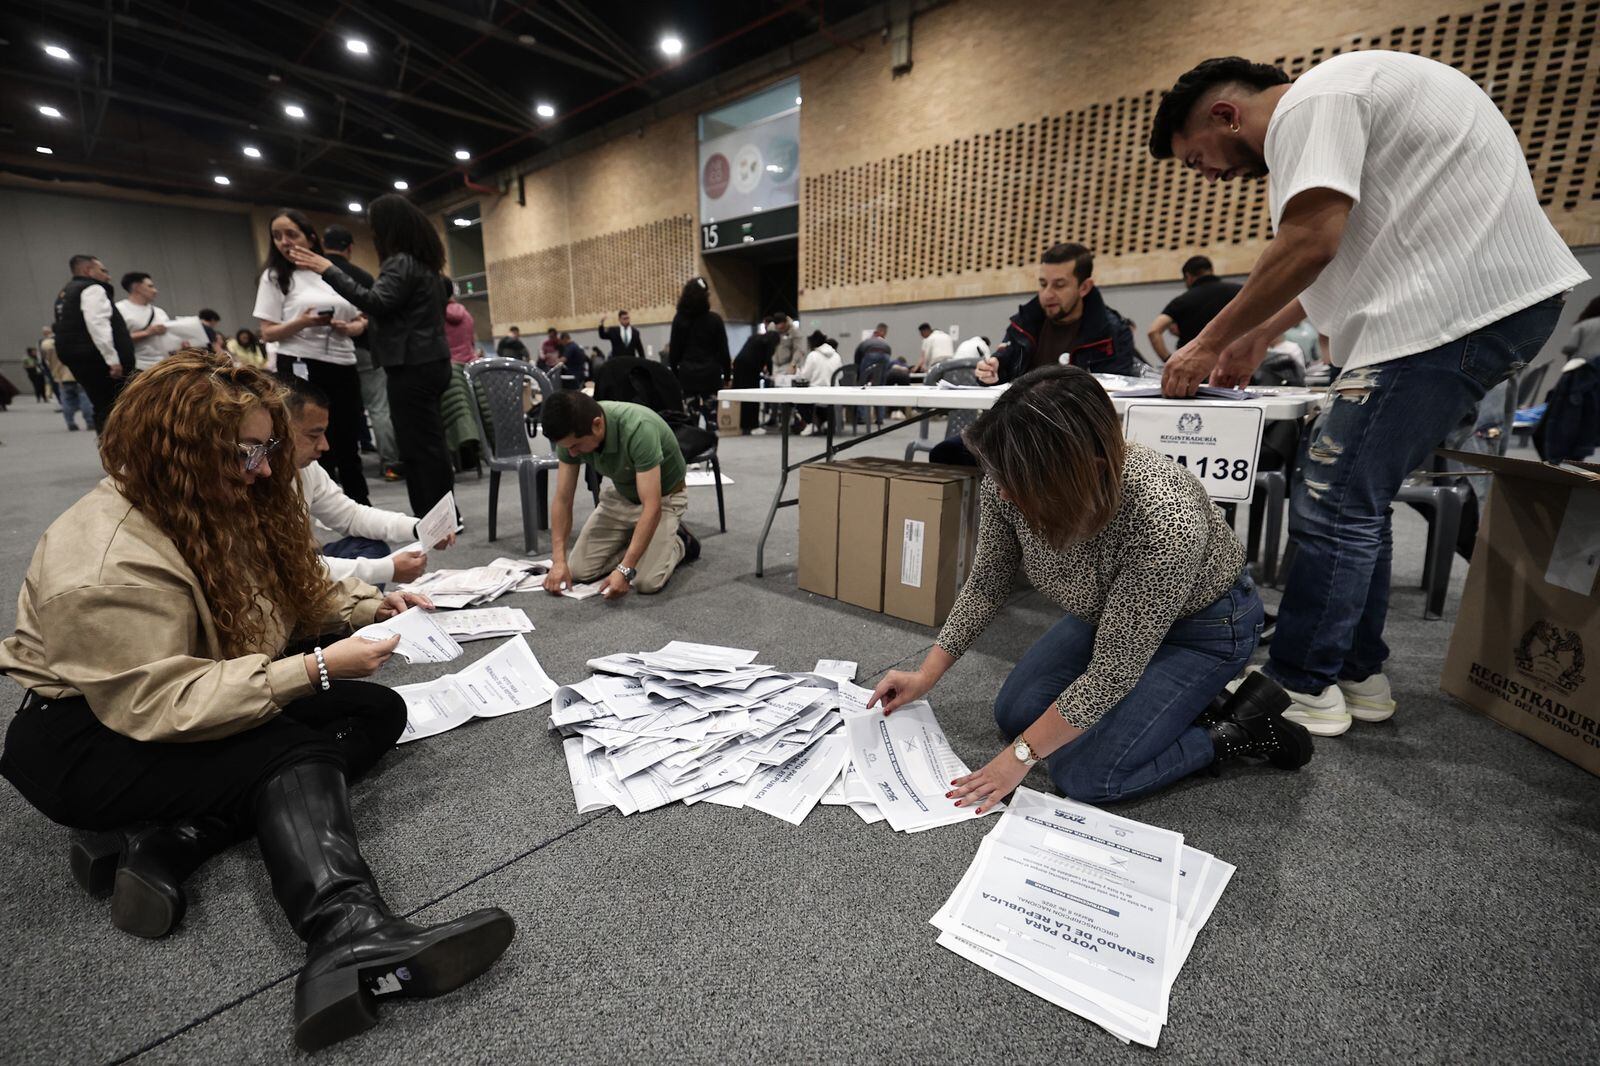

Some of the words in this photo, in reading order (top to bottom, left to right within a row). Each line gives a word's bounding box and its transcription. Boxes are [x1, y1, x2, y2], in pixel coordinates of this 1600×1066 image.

[703, 224, 718, 248] 15
[1196, 457, 1249, 481] 138
[1467, 674, 1512, 704] NACIONAL
[1514, 700, 1532, 714] DEL
[1536, 710, 1580, 737] ESTADO
[1052, 811, 1086, 824] 2026
[1131, 848, 1159, 860] MARCAR
[1015, 895, 1051, 912] NACIONAL
[1022, 917, 1058, 936] PARA
[1053, 920, 1071, 932] LA
[1073, 928, 1092, 940] DE
[1061, 931, 1099, 953] VOTO
[1095, 935, 1154, 965] SENADO
